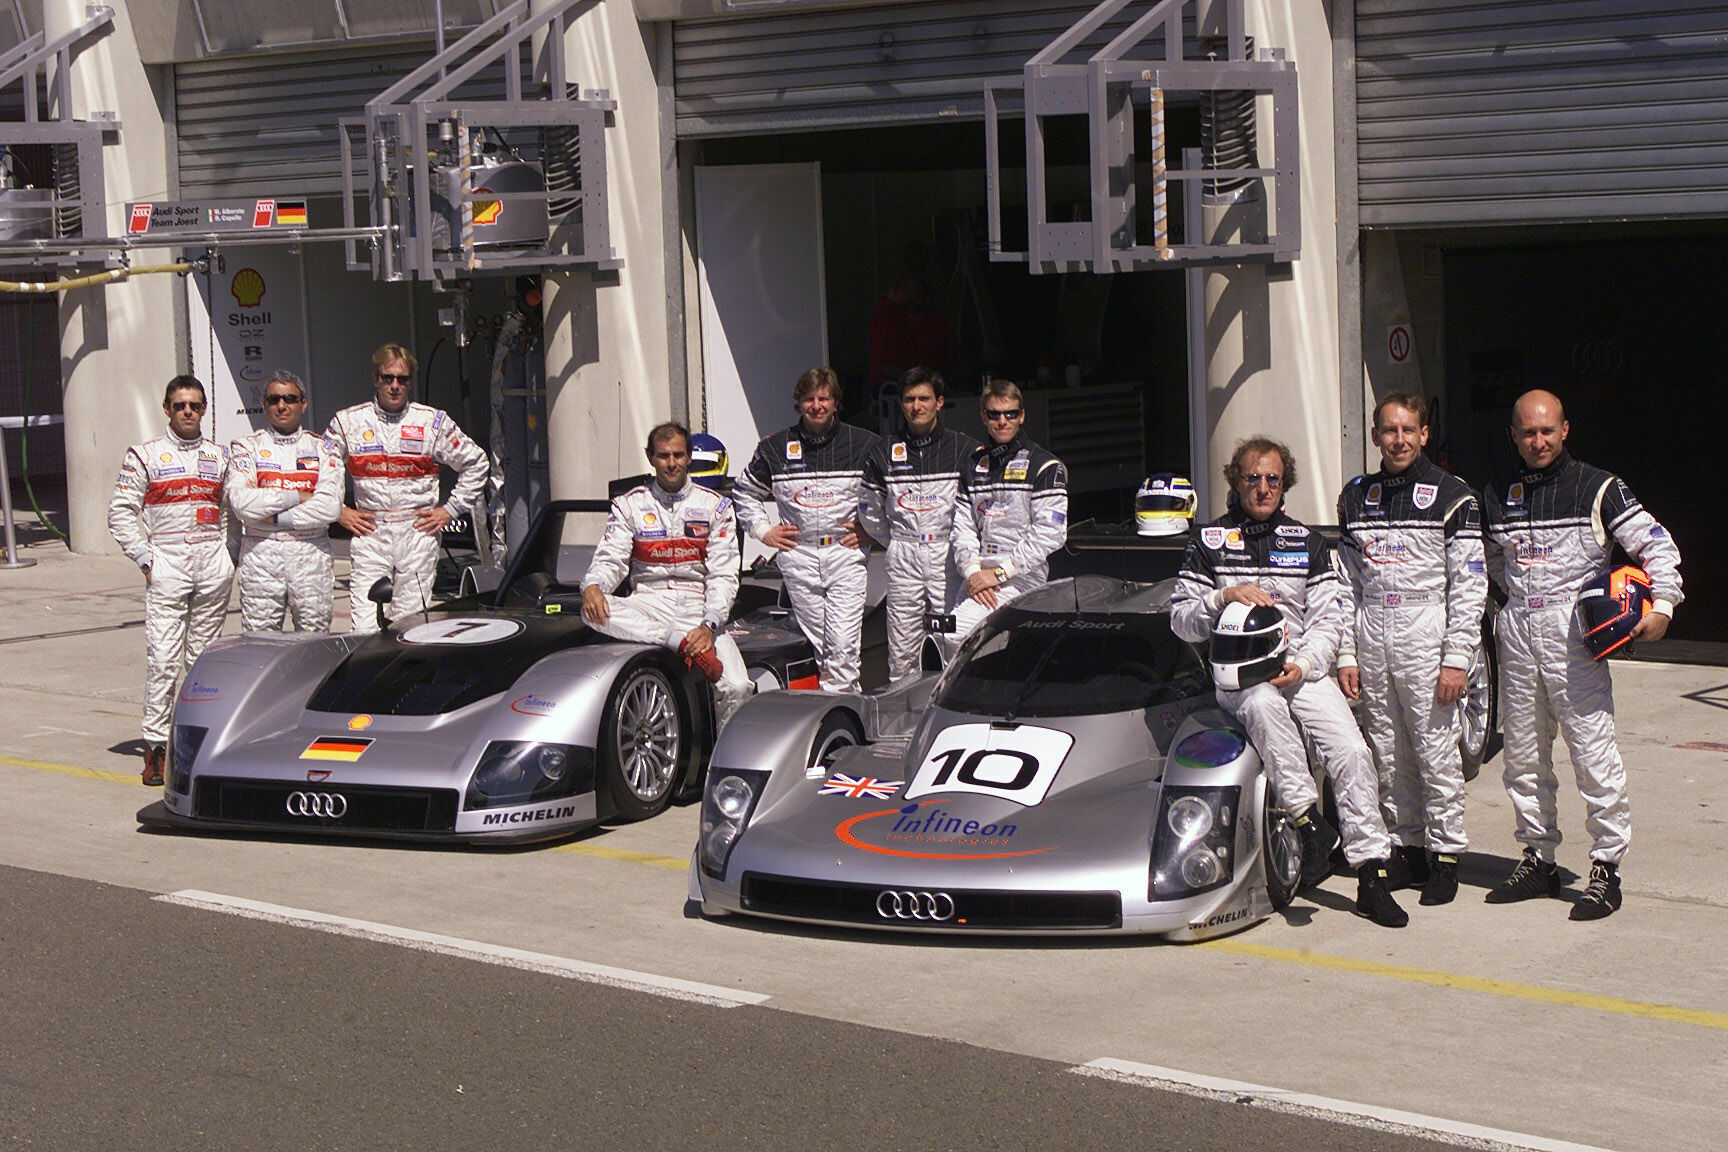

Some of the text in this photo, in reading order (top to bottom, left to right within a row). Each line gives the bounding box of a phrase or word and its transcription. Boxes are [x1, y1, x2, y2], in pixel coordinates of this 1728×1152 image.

[152, 205, 200, 217] Audi Sport
[151, 217, 198, 228] Team Joest
[228, 312, 271, 326] Shell
[239, 329, 264, 337] OZ
[365, 461, 415, 473] Audi Sport
[282, 479, 312, 490] Sport
[165, 486, 189, 497] Audi
[650, 548, 673, 558] Audi
[1269, 555, 1309, 563] OLYMPUS
[441, 622, 490, 638] 7
[1017, 619, 1126, 631] Audi Sport
[931, 749, 1040, 791] 10
[483, 806, 576, 825] MICHELIN
[886, 833, 1009, 846] technologies
